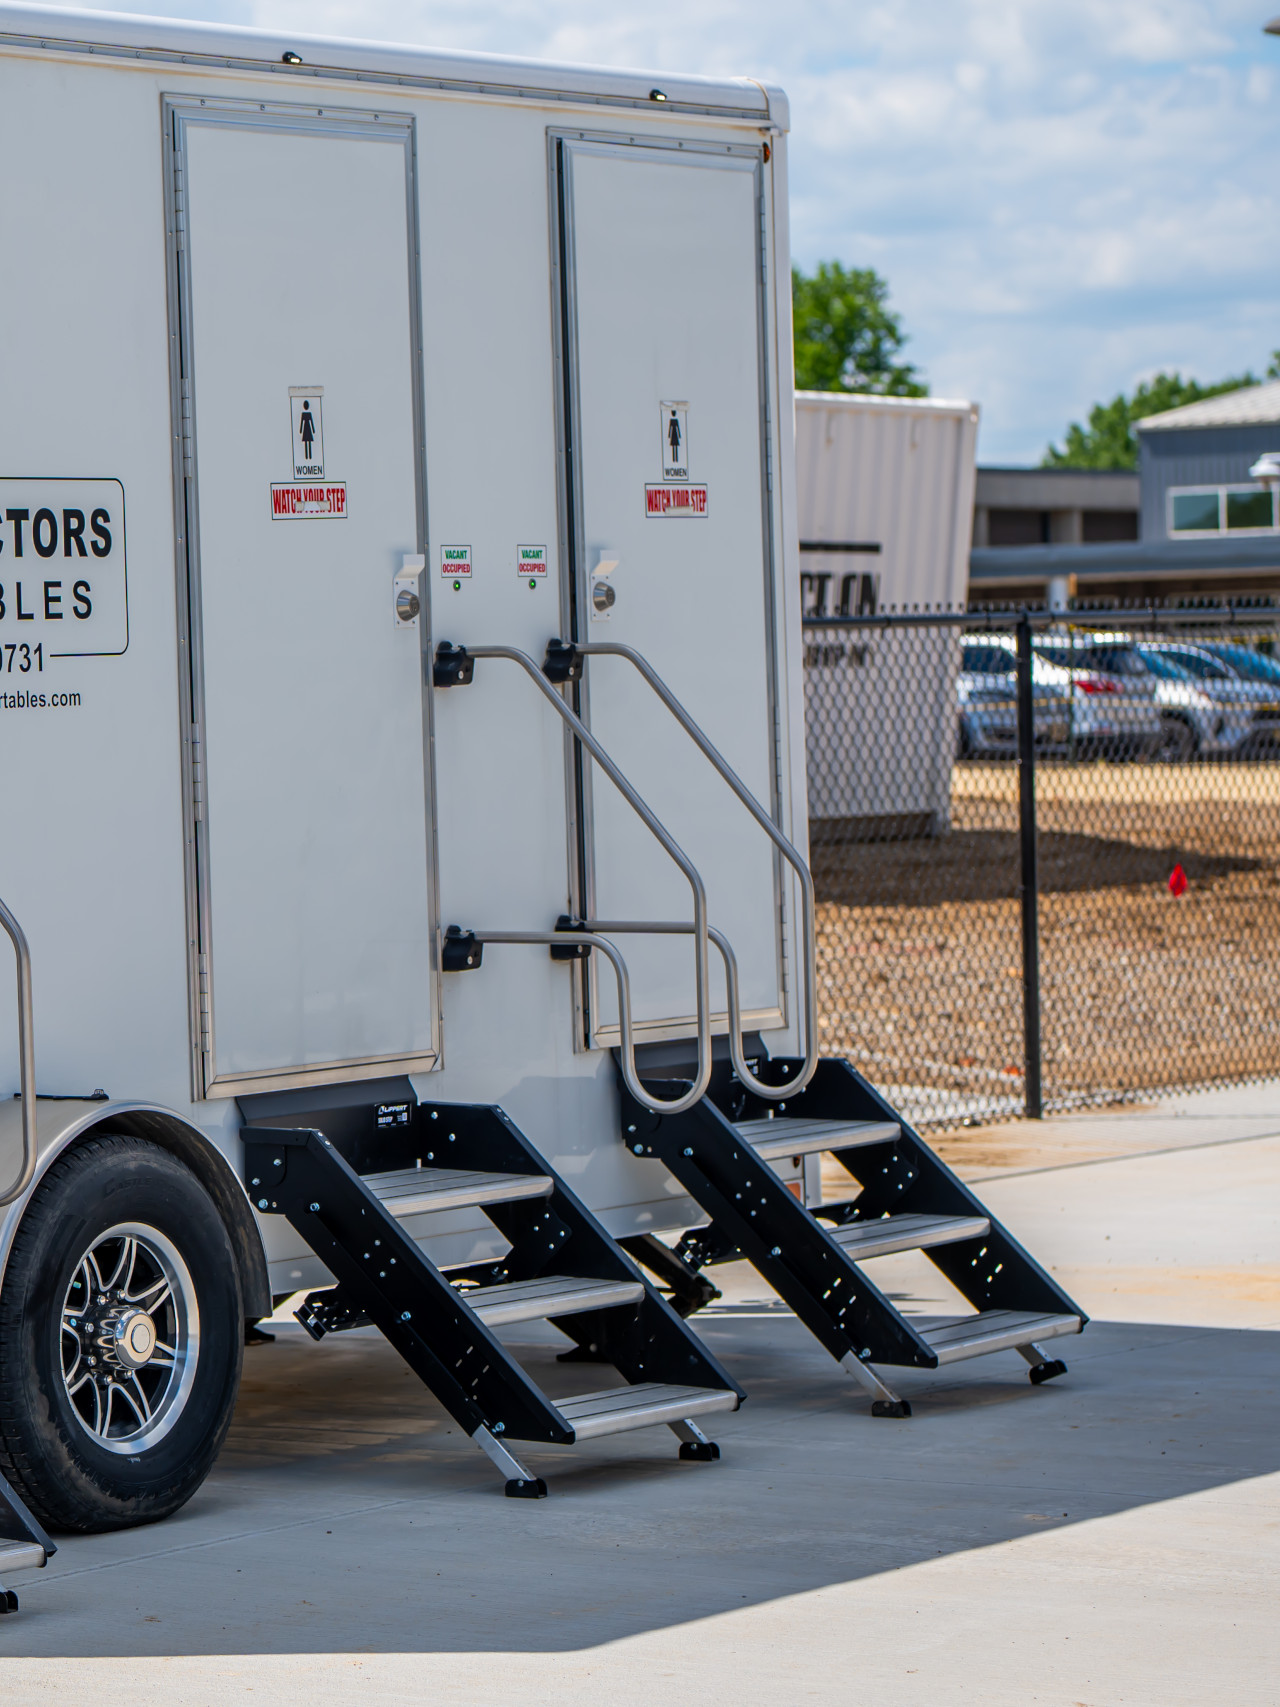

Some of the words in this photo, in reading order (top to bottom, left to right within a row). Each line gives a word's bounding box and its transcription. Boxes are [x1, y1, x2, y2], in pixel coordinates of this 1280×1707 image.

[295, 465, 323, 475] WOMEN
[665, 468, 687, 477] WOMEN
[272, 489, 302, 514] WATCH
[326, 488, 345, 513] STEP
[646, 489, 671, 513] WATCH
[690, 489, 707, 512] STEP
[444, 550, 468, 560] VACANT
[521, 550, 543, 559] VACANT
[442, 563, 471, 573] OCCUPIED
[518, 563, 546, 573] OCCUPIED
